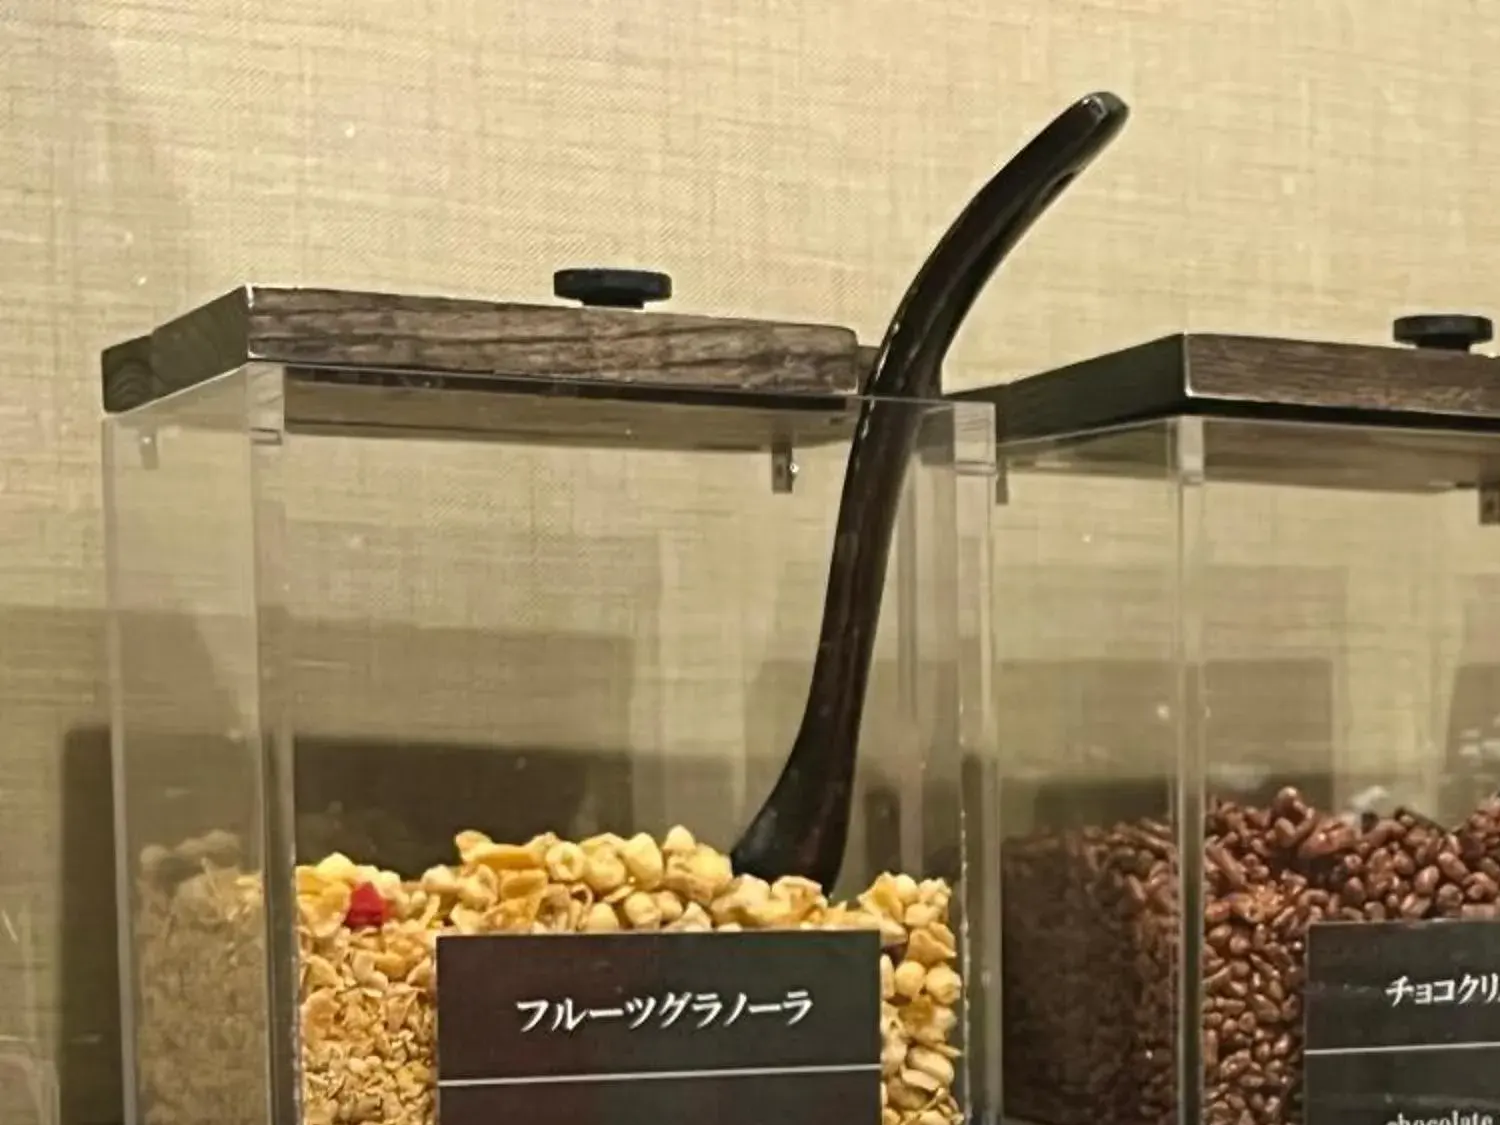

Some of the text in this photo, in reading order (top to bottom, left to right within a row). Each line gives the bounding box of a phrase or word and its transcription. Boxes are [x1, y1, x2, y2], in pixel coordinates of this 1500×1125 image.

[516, 991, 814, 1033] フルーツグラノーラ
